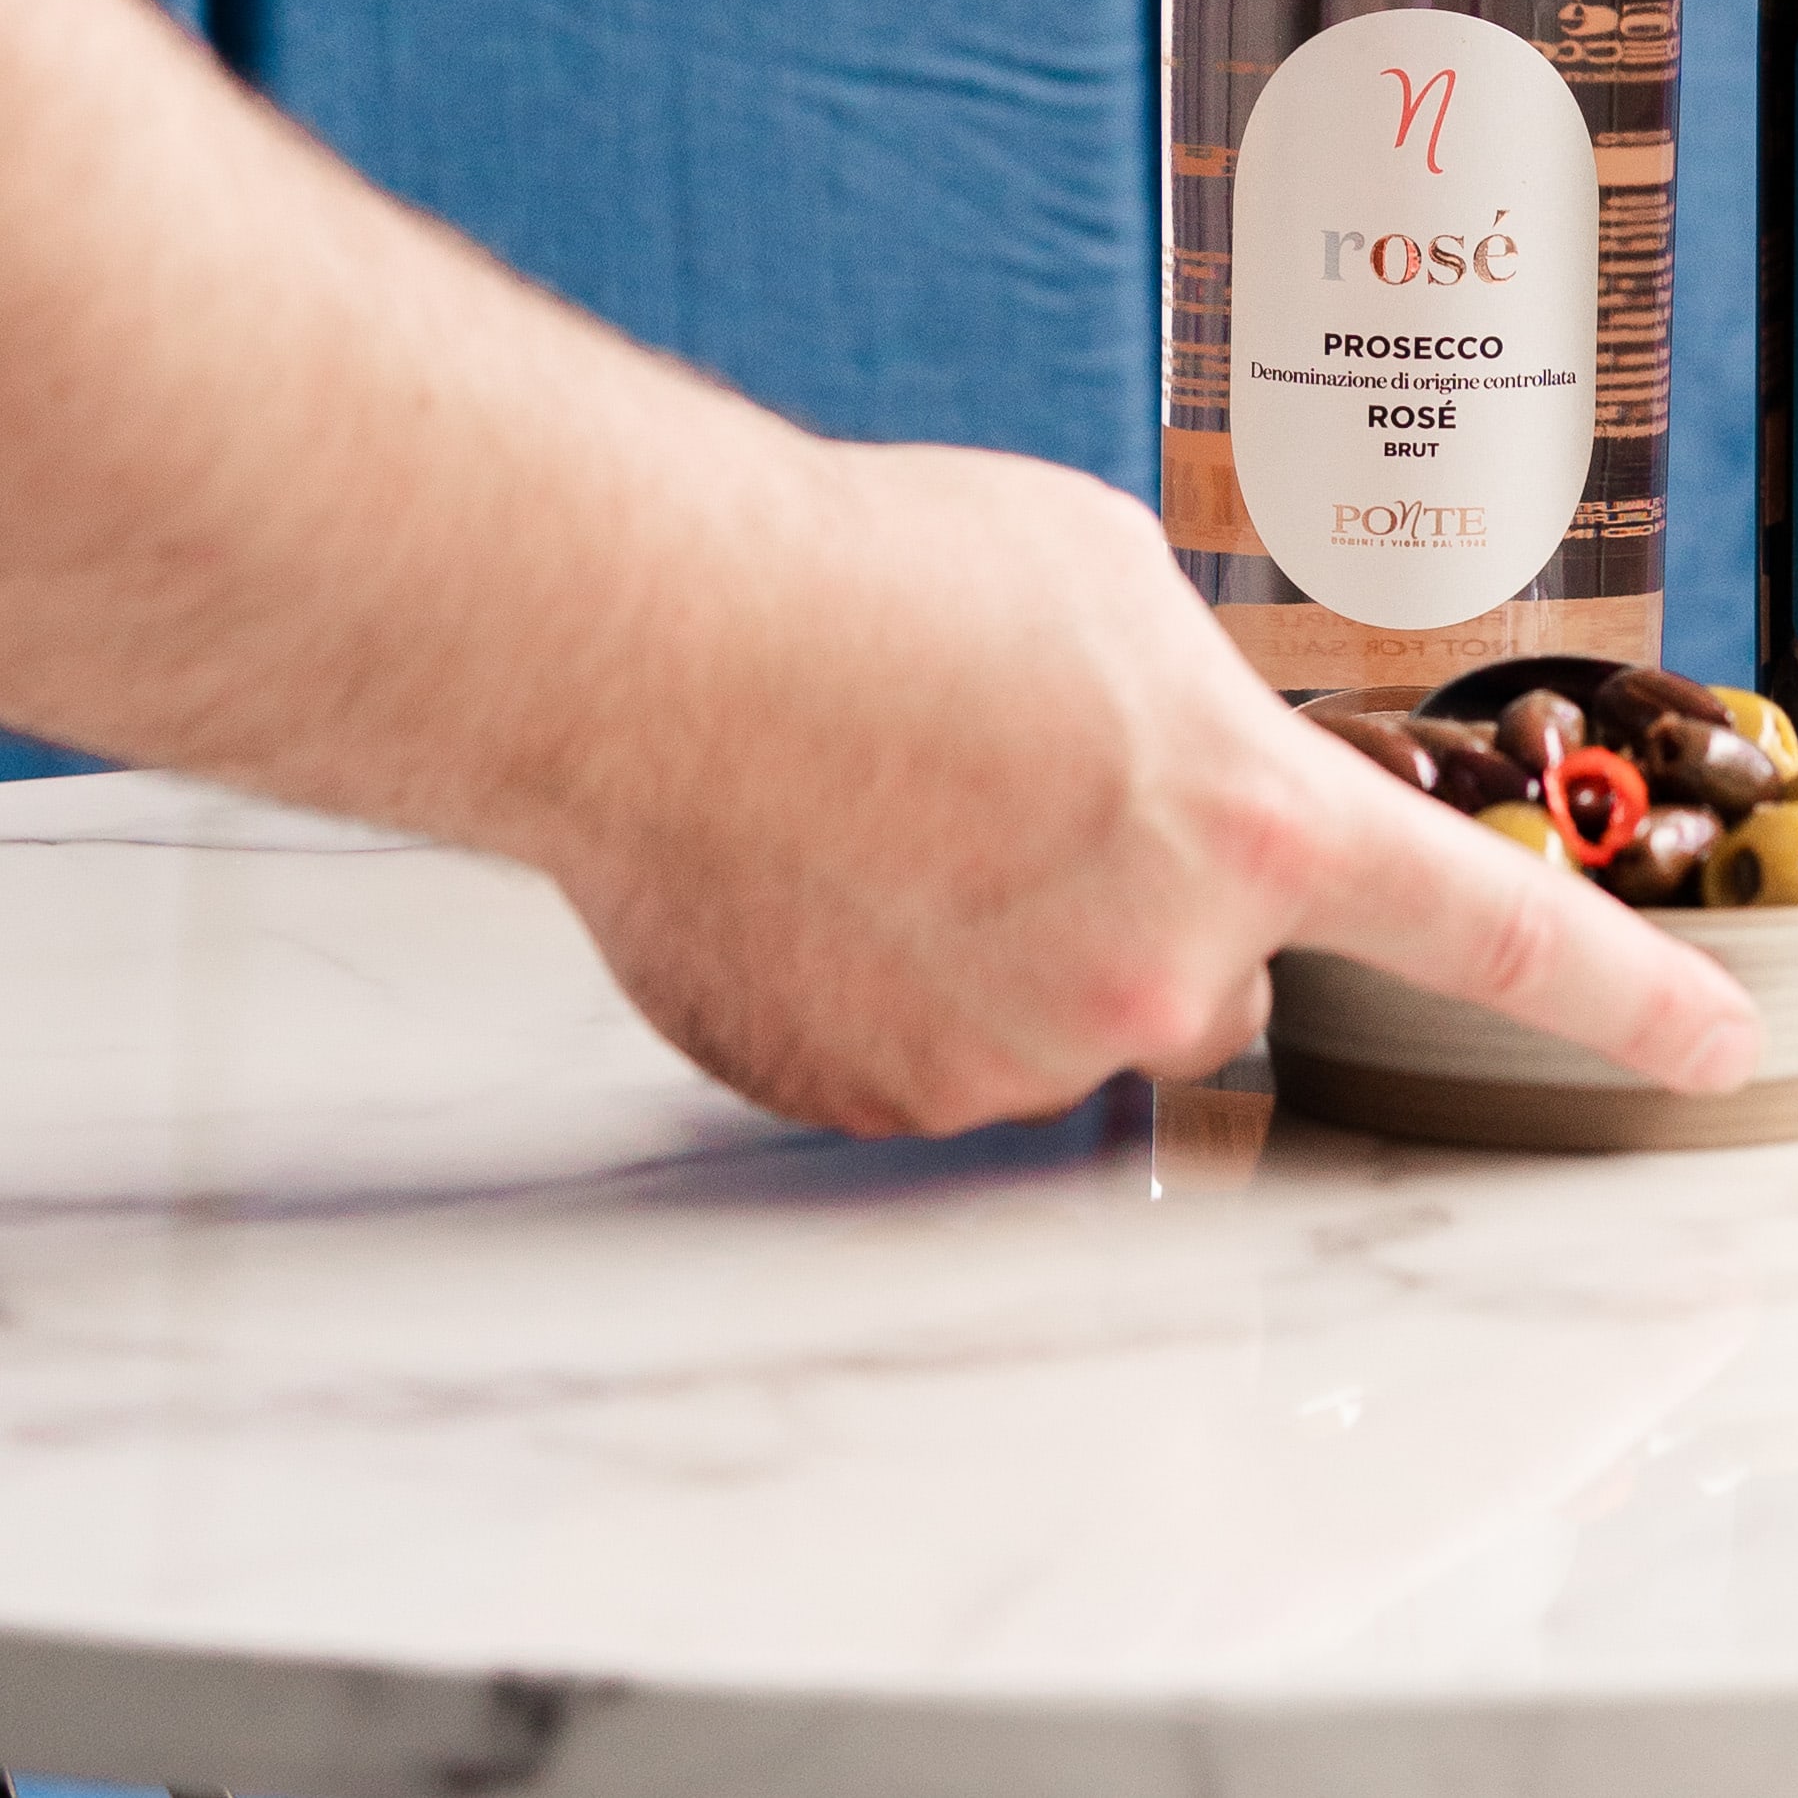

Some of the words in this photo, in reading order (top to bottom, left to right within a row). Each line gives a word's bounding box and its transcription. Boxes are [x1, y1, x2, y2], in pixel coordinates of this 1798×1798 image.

[1320, 209, 1519, 286] rosé
[1324, 333, 1504, 360] PROSECCO
[1250, 361, 1388, 390] Denominazione
[1391, 371, 1409, 390] di
[1413, 373, 1480, 395] origine
[1483, 368, 1577, 390] controllata
[1368, 400, 1457, 429] ROSÉ
[1383, 442, 1440, 457] BRUT
[1432, 539, 1453, 548] DAL
